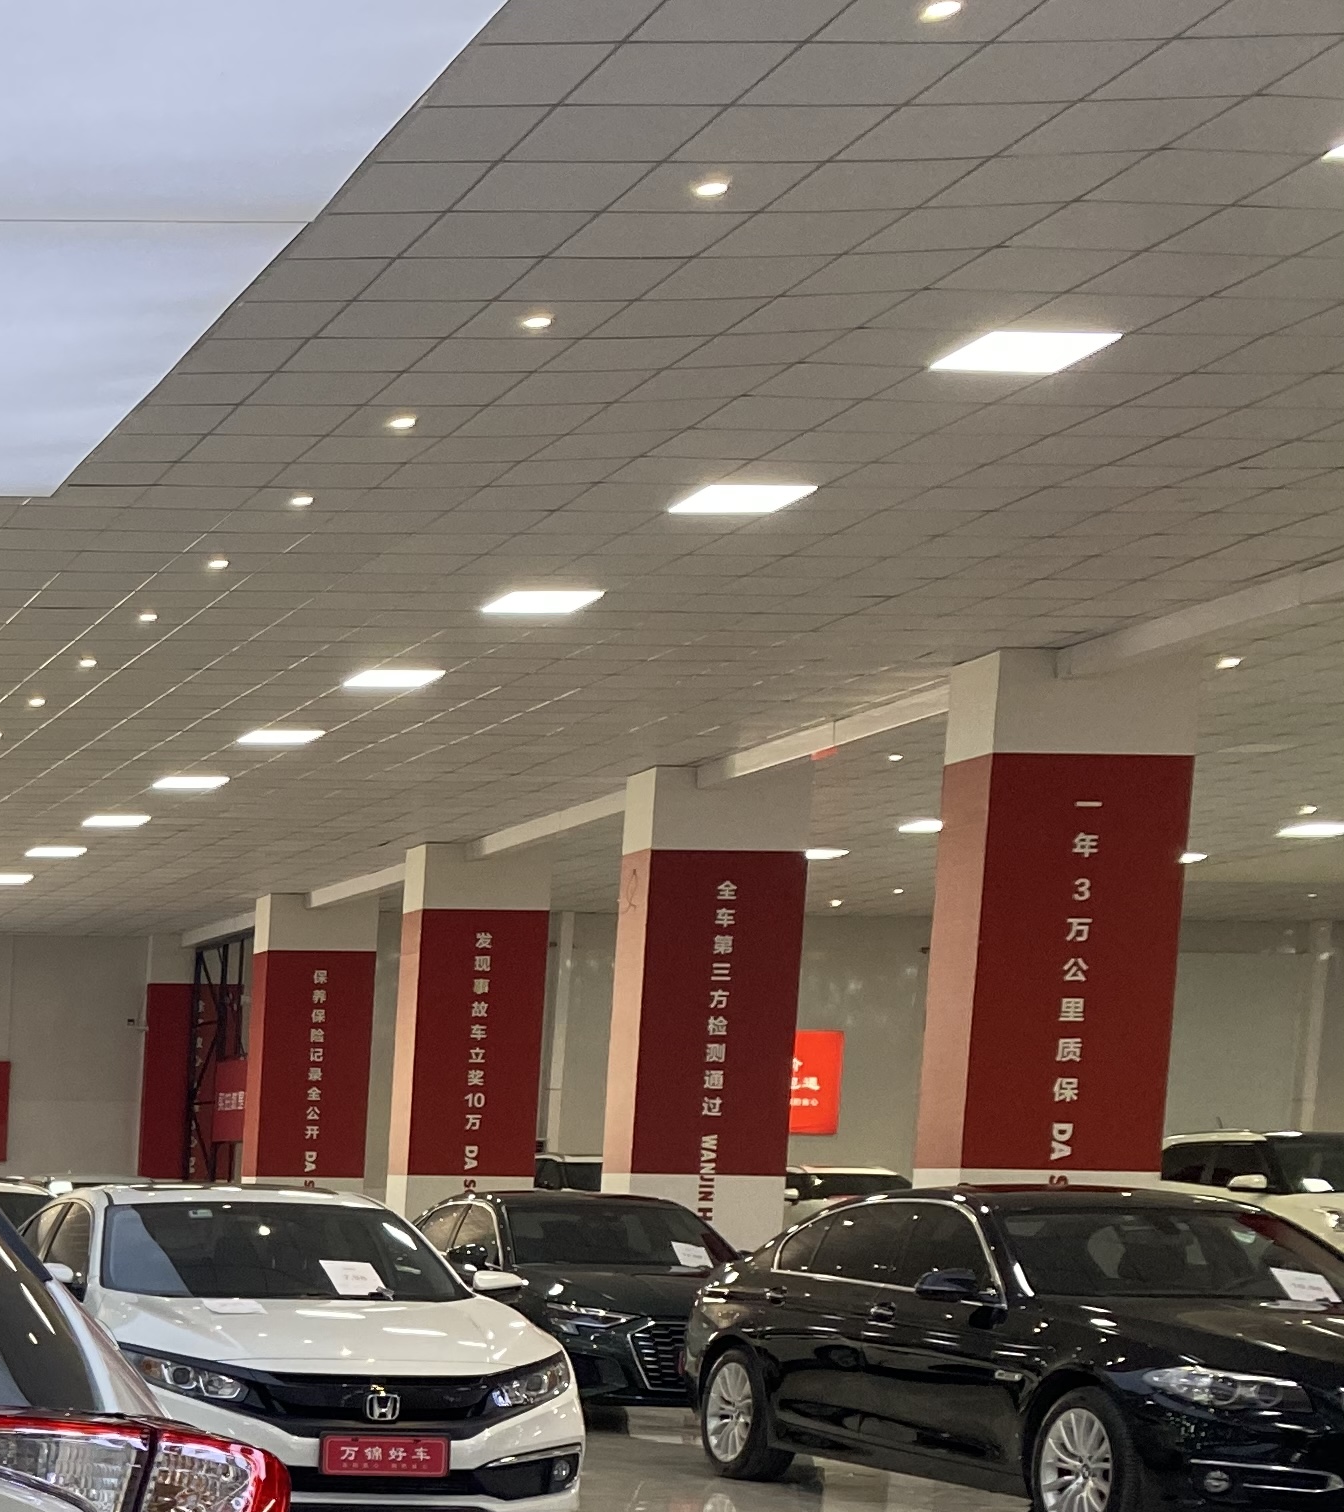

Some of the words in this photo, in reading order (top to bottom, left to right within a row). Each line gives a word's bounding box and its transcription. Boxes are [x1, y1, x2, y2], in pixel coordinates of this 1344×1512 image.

[1053, 800, 1103, 1103] 一年3万公里质保
[464, 932, 493, 1131] 发现事故车立奖10万
[702, 880, 738, 1116] 全车第三方检测通过
[304, 969, 329, 1140] 保养保险记录全公开
[304, 1151, 317, 1172] DA
[464, 1145, 478, 1170] DA
[698, 1134, 719, 1202] WANJIN
[1050, 1123, 1073, 1160] DA
[340, 1446, 431, 1461] 万锦好车
